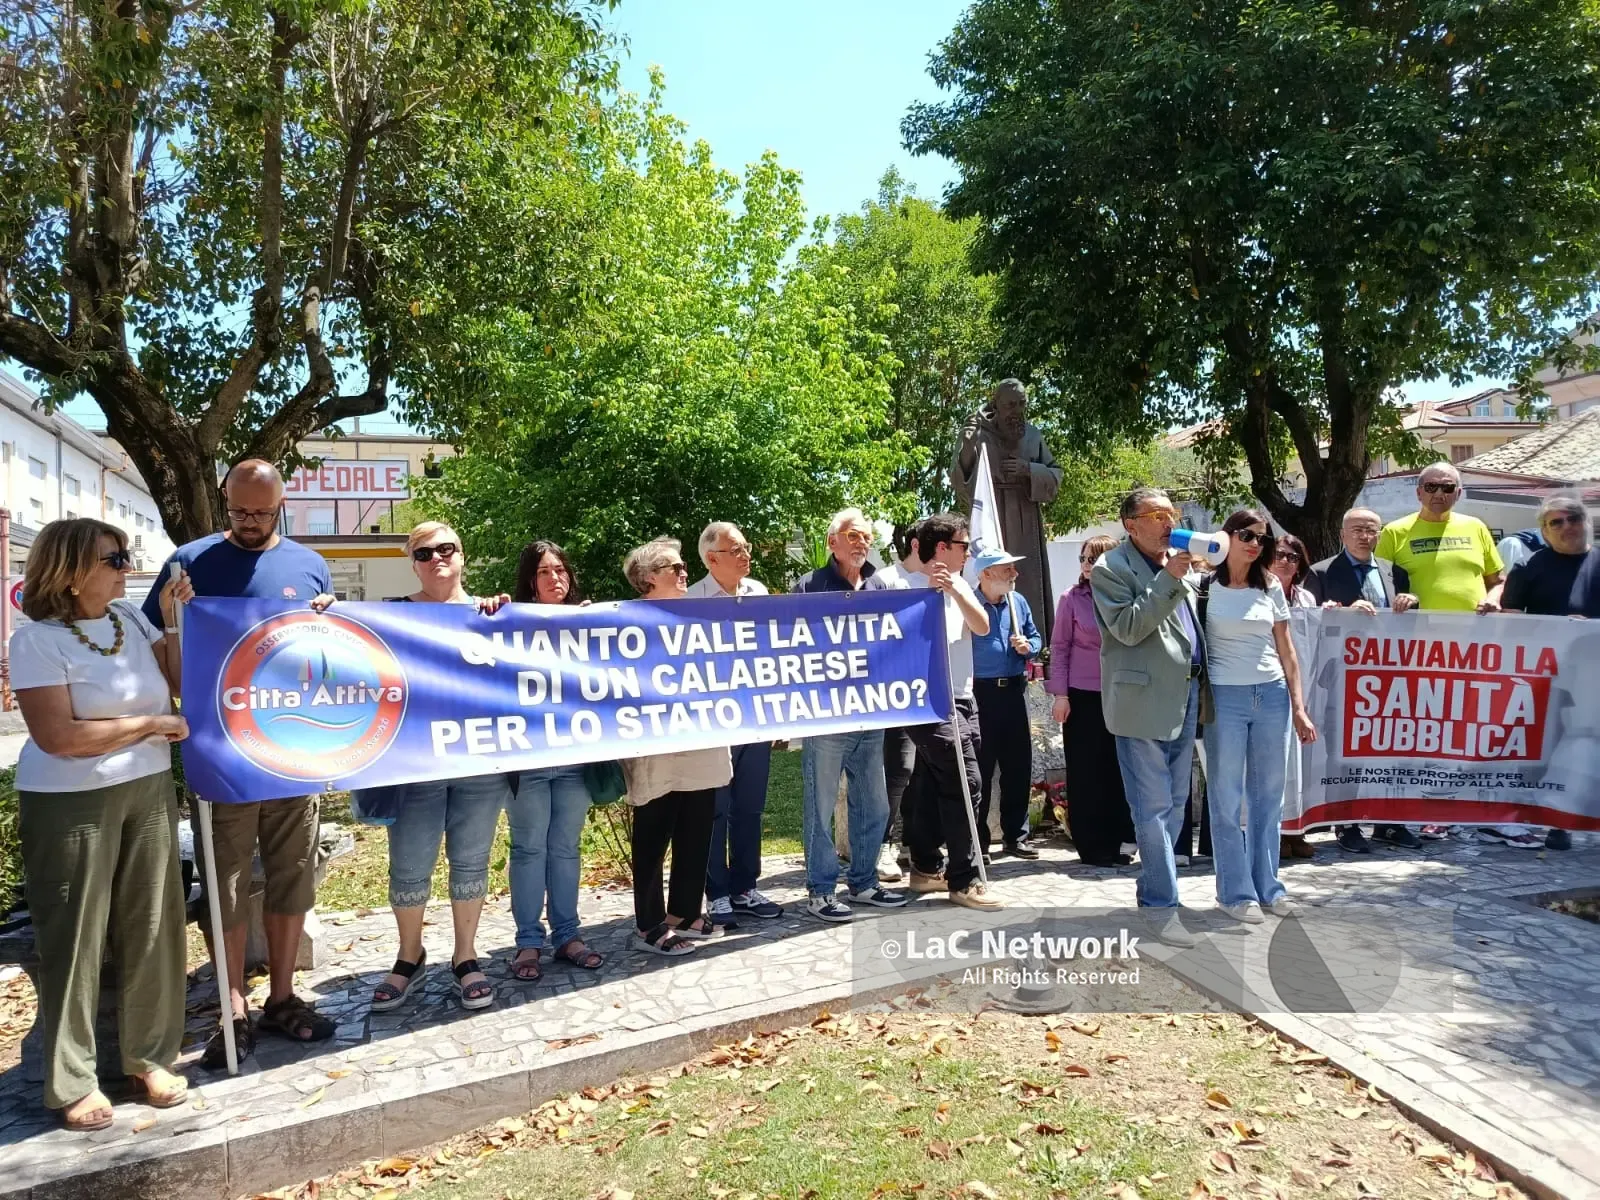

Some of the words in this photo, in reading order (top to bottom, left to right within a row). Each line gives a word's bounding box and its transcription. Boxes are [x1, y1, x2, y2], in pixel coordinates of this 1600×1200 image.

[286, 466, 400, 492] SPEDALE
[459, 625, 647, 669] QUANTO
[660, 620, 758, 656] VALE
[769, 616, 813, 649] LA
[823, 612, 903, 643] VITA
[1343, 636, 1502, 672] SALVIAMO
[1514, 645, 1559, 676] LA
[516, 669, 561, 706] DI
[580, 665, 641, 701] UN
[651, 649, 868, 695] CALABRESE
[430, 715, 529, 757] PER
[545, 710, 600, 748] LO
[616, 697, 743, 740] STATO
[754, 678, 928, 723] ITALIANO?
[1354, 674, 1535, 725] SANITÀ
[1350, 716, 1527, 757] PUBBLICA
[1320, 776, 1393, 785] RECUPERARE
[1396, 777, 1407, 785] IL
[1409, 777, 1466, 788] DIRITTO
[1468, 780, 1504, 788] ALLA
[1508, 781, 1566, 792] SALUTE
[1349, 767, 1363, 776] LE
[1365, 768, 1416, 777] NOSTRE
[1418, 769, 1493, 780] PROPOSTE
[1495, 772, 1524, 780] PER
